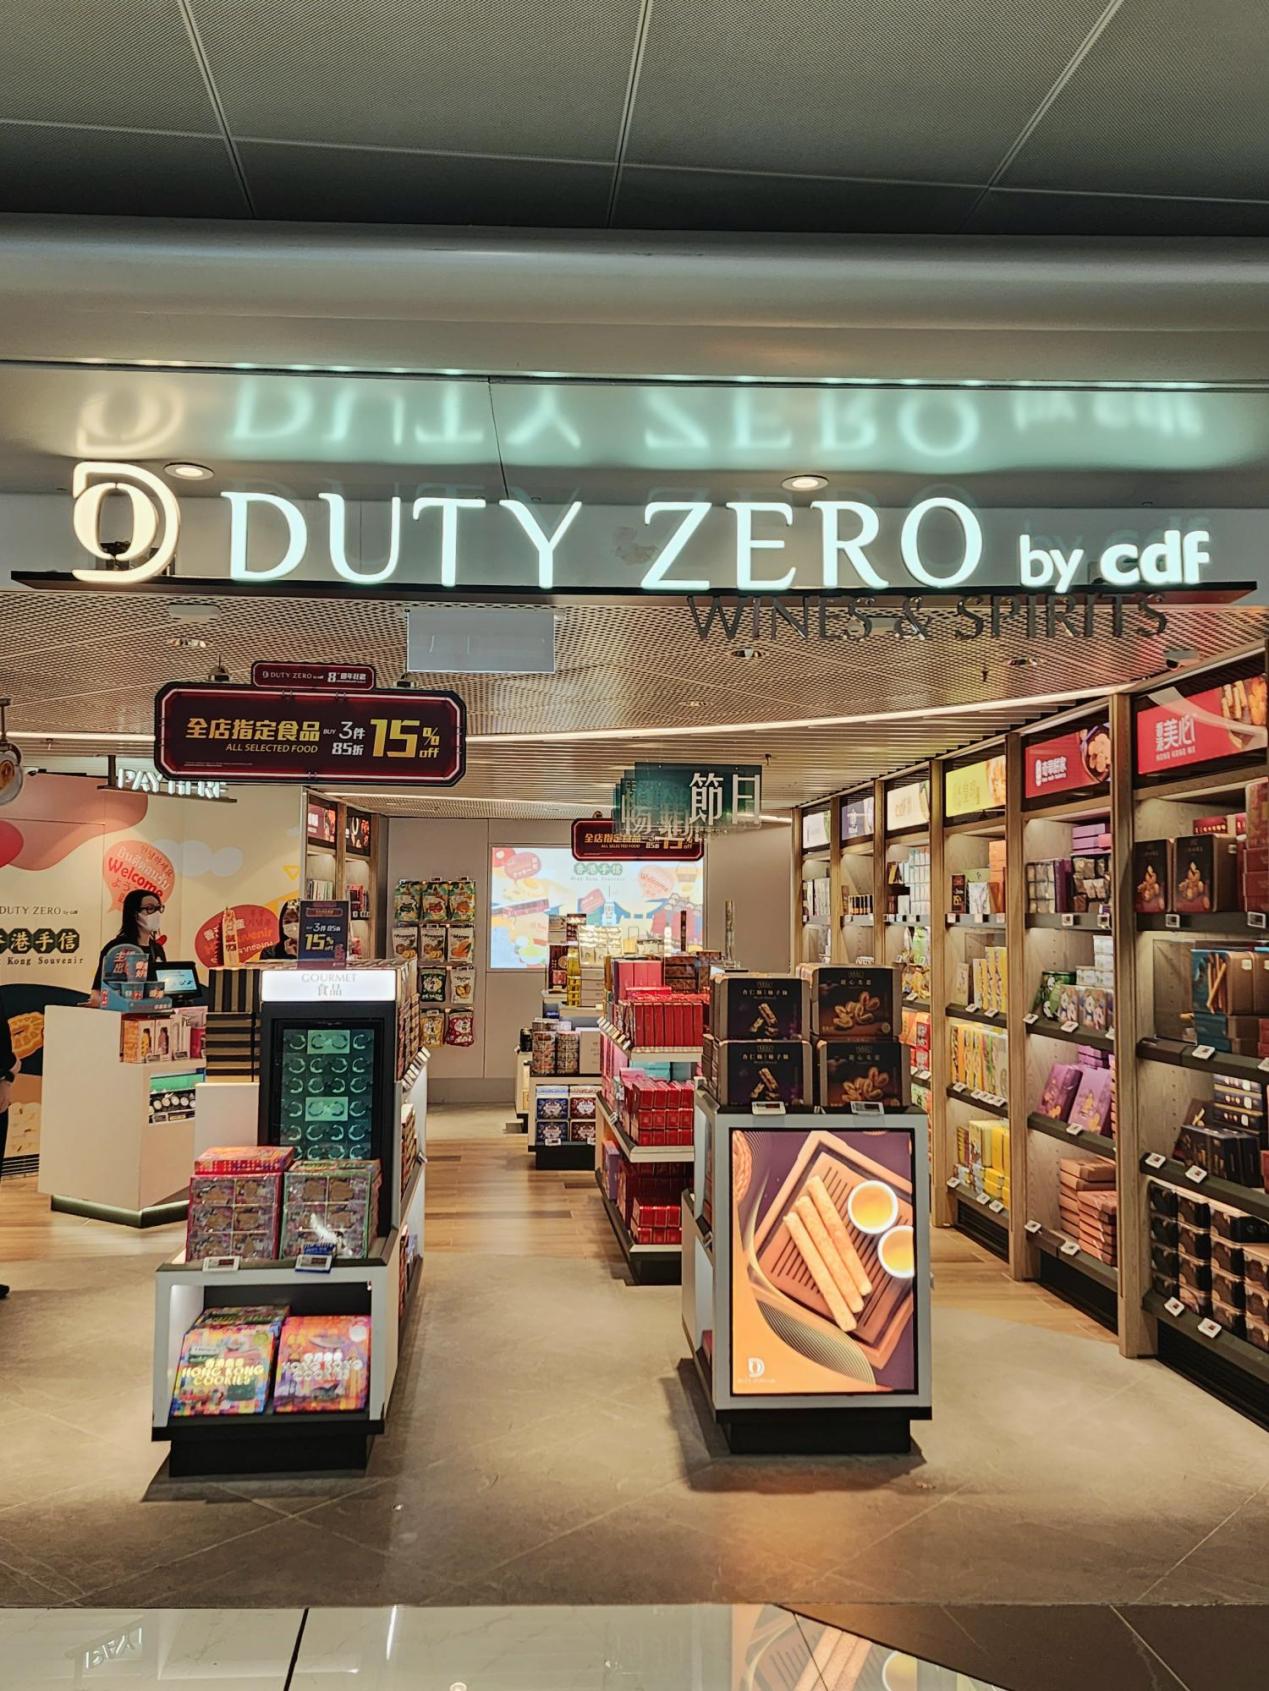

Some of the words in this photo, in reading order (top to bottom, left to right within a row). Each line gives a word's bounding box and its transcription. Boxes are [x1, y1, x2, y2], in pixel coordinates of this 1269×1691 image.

[221, 491, 583, 588] DUTY
[640, 497, 983, 591] ZERO
[1019, 535, 1084, 593] by
[1100, 530, 1210, 585] cdf
[688, 593, 874, 641] WINES
[954, 592, 1168, 641] SPIRITS
[185, 718, 320, 742] 全店指定食品
[225, 743, 243, 752] ALL
[244, 743, 290, 753] SELECTED
[291, 744, 318, 753] FOOD
[419, 748, 440, 758] off
[117, 768, 164, 793] PAY
[689, 772, 761, 826] 節日
[108, 857, 164, 898] Welcome
[33, 905, 61, 915] ZERO
[7, 956, 32, 966] Kong
[38, 956, 84, 965] Souvenir
[301, 973, 356, 983] GOURMET
[182, 1367, 222, 1378] HONG
